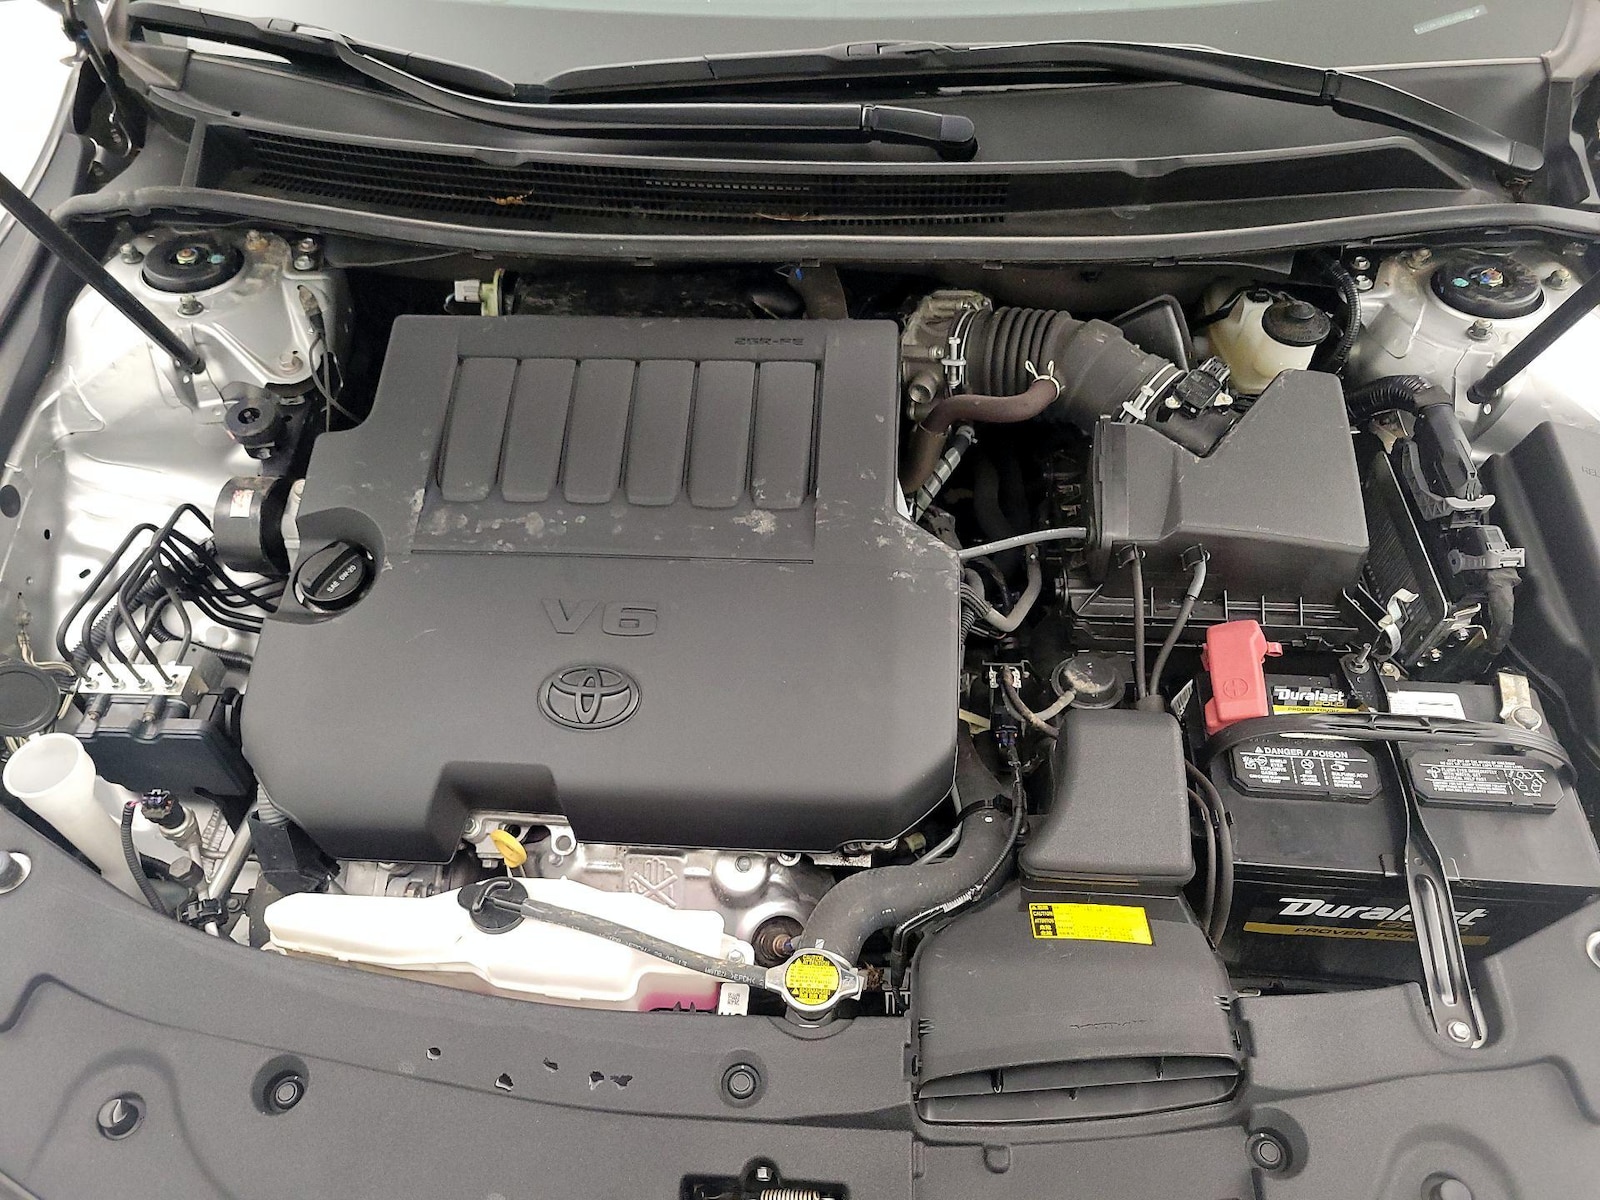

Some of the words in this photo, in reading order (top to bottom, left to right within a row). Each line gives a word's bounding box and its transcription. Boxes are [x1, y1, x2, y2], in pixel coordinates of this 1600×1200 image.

[326, 580, 341, 593] SAE
[339, 564, 357, 581] 0W-20
[540, 599, 659, 637] V6
[1274, 688, 1345, 702] Duralast
[1263, 746, 1304, 757] DANGER
[1312, 749, 1349, 759] POISON
[1294, 927, 1369, 936] PROVEN
